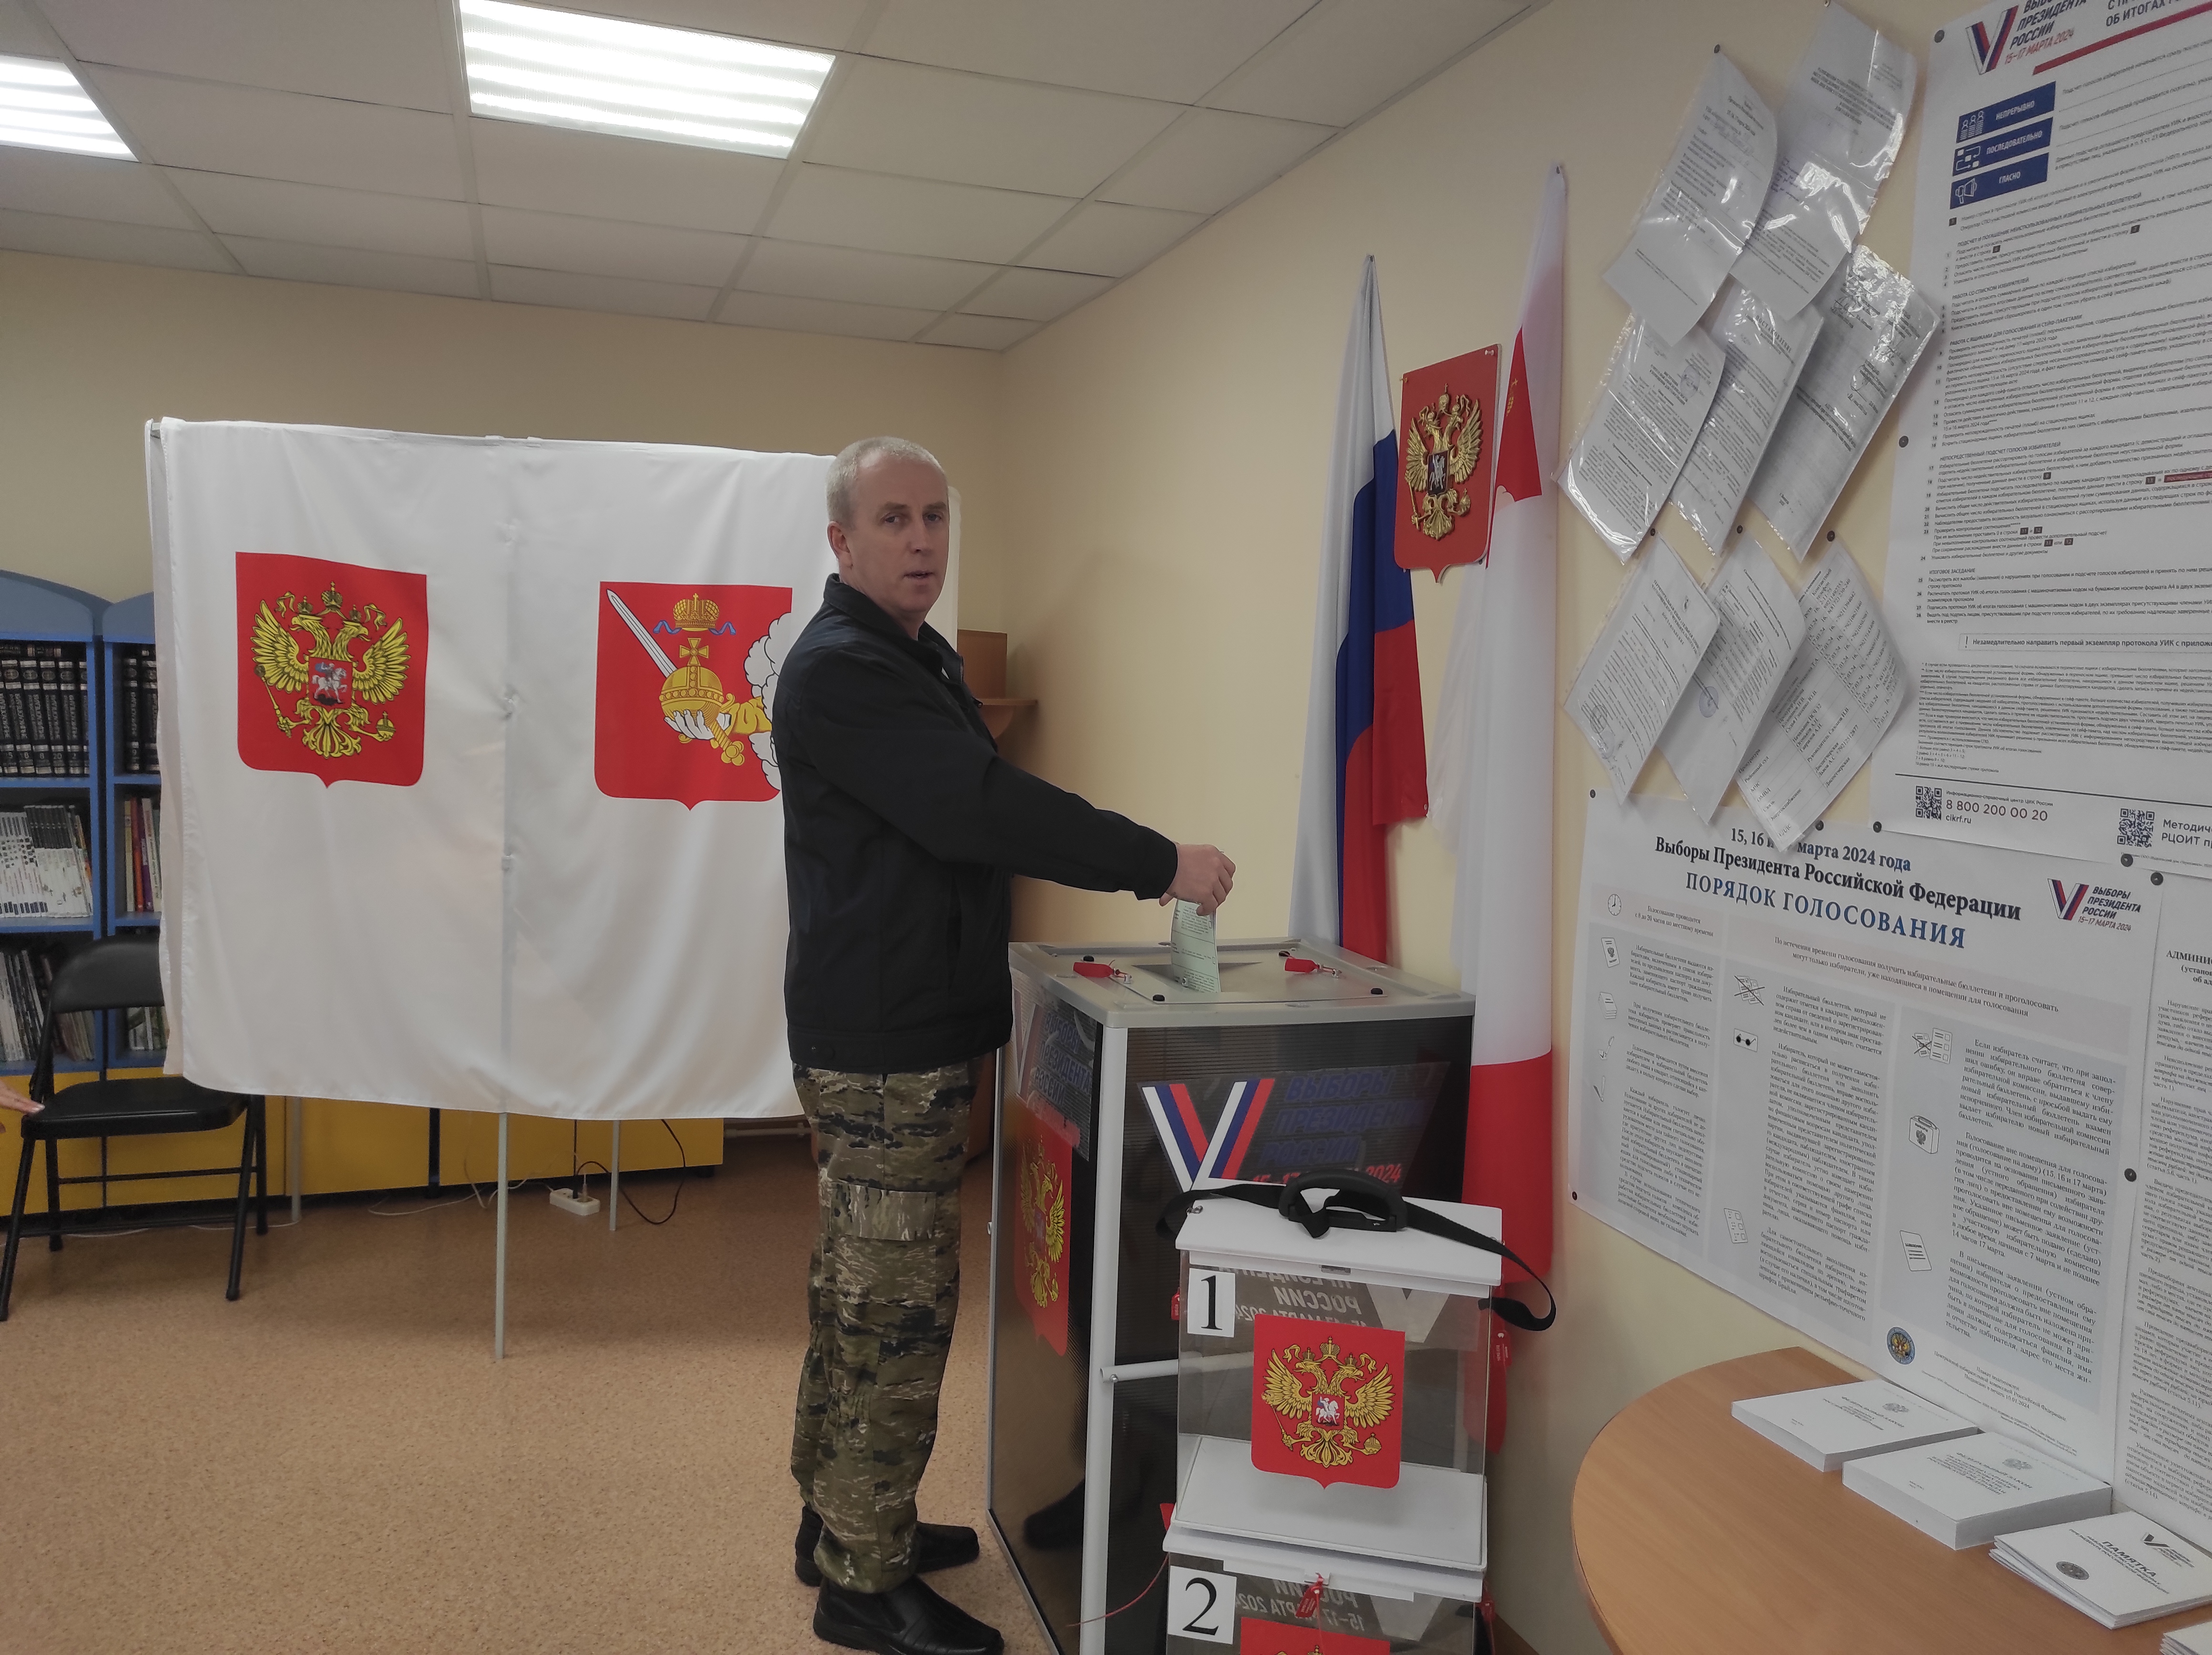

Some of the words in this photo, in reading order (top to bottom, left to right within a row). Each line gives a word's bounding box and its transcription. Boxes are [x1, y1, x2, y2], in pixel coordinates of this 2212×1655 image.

[2106, 13, 2120, 27] ОБ
[2009, 22, 2055, 49] РОССИИ
[1996, 101, 2035, 120] НЕПРЕРЫВНО
[1986, 131, 2043, 154] ПОСЛЕДОВАТЕЛЬНО
[1999, 172, 2021, 184] ГЛАСНО
[1940, 451, 1985, 461] НЕПОСРЕДСТВЕННЫЙ
[2028, 442, 2061, 450] ИЗБИРАТЕЛЕЙ
[1946, 791, 2009, 801] Информационно-справочный
[1946, 799, 1953, 810] 8
[1956, 801, 1980, 813] 800
[1983, 804, 2007, 816] 200
[2010, 807, 2028, 819] 00
[2032, 809, 2048, 821] 20
[1946, 814, 1972, 824] cikrf.ru
[2163, 819, 2212, 833] Методич
[1731, 828, 1747, 845] 15,
[1751, 831, 1764, 847] 16
[1797, 841, 1839, 860] марта
[1842, 847, 1876, 865] 2024
[1879, 856, 1911, 873] года
[2161, 833, 2201, 845] РЦОИТ
[1655, 837, 1710, 863] Выборы
[1713, 847, 1801, 878] Президента
[1804, 864, 1905, 898] Российской
[1909, 883, 2021, 920] Федерации
[2087, 897, 2141, 912] ПРЕЗИДЕНТА
[2092, 887, 2131, 899] ВЫБОРЫ
[1648, 906, 1675, 918] Голосование
[1676, 914, 1701, 924] проводится
[1686, 873, 1776, 907] ПОРЯДОК
[1782, 893, 1966, 947] ГОЛОСОВАНИЯ
[2081, 907, 2118, 919] РОССИИ
[1673, 922, 1694, 932] местному
[1694, 928, 1714, 937] времени
[2078, 916, 2096, 925] 15–17
[2095, 919, 2116, 929] МАРТА
[2116, 923, 2131, 932] 2024
[1783, 941, 1811, 952] истечении
[1812, 948, 1836, 958] времени
[1838, 954, 1876, 967] голосования
[1877, 963, 1906, 975] получить
[1907, 971, 1957, 987] избирательные
[1958, 981, 1997, 997] бюллетени
[2005, 995, 2059, 1012] проголосовать
[1793, 953, 1808, 962] могут
[1809, 957, 1829, 966] только
[1830, 962, 1866, 976] избиратели,
[1881, 971, 1923, 989] находящиеся
[1929, 987, 1967, 1001] помещении
[1984, 1001, 2028, 1017] голосования
[1966, 1048, 1985, 1058] нении
[1990, 1055, 2042, 1074] избирательного
[2048, 1070, 2085, 1086] бюллетеня
[2092, 1084, 2115, 1094] совер-
[1975, 1040, 1990, 1050] Если
[1993, 1046, 2029, 1061] избиратель
[2032, 1057, 2059, 1070] считает,
[2076, 1070, 2089, 1078] при
[2091, 1074, 2116, 1083] запол-
[1285, 1071, 1395, 1102] ВЫБОРЫ
[1964, 1067, 2010, 1085] избирательной
[2013, 1082, 2047, 1096] комиссии,
[2049, 1093, 2090, 1109] выдавшему
[2092, 1105, 2113, 1114] изби-
[1965, 1057, 1978, 1066] шил
[1980, 1062, 2006, 1074] ошибку,
[2018, 1073, 2041, 1084] вправе
[2043, 1080, 2082, 1096] обратиться
[2092, 1094, 2114, 1105] члену
[1961, 1085, 1981, 1095] новый
[1987, 1093, 2037, 1112] избирательный
[2042, 1108, 2080, 1125] бюллетень
[2086, 1124, 2111, 1135] взамен
[1962, 1076, 1995, 1090] рательный
[2039, 1099, 2070, 1113] просьбой
[2072, 1109, 2097, 1121] выдать
[2099, 1117, 2113, 1126] ему
[1260, 1136, 1362, 1166] РОССИИ
[1200, 1275, 1223, 1331] 1
[2006, 1395, 2029, 1409] 10.01.2024
[2102, 1541, 2156, 1577] ПАМЯТКА
[1182, 1577, 1219, 1636] 2
